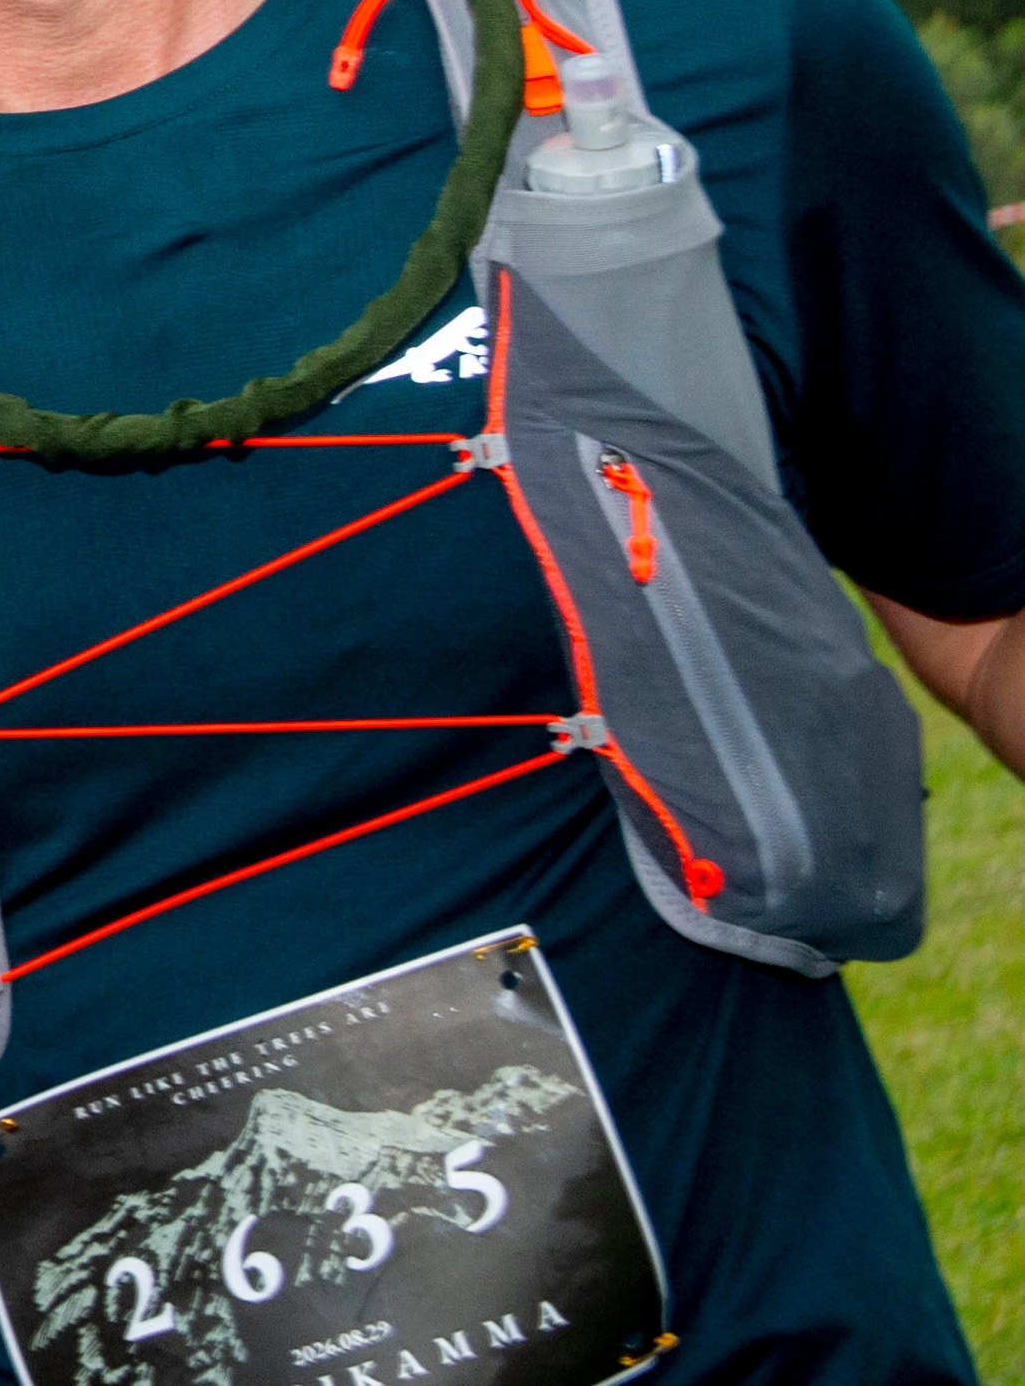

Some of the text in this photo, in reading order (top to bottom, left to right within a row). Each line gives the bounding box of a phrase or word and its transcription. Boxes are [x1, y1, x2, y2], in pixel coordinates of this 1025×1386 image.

[73, 1000, 393, 1120] RUN LIKE THE TREES ARE
[171, 1054, 300, 1106] CHEERING
[105, 1139, 510, 1342] 2635
